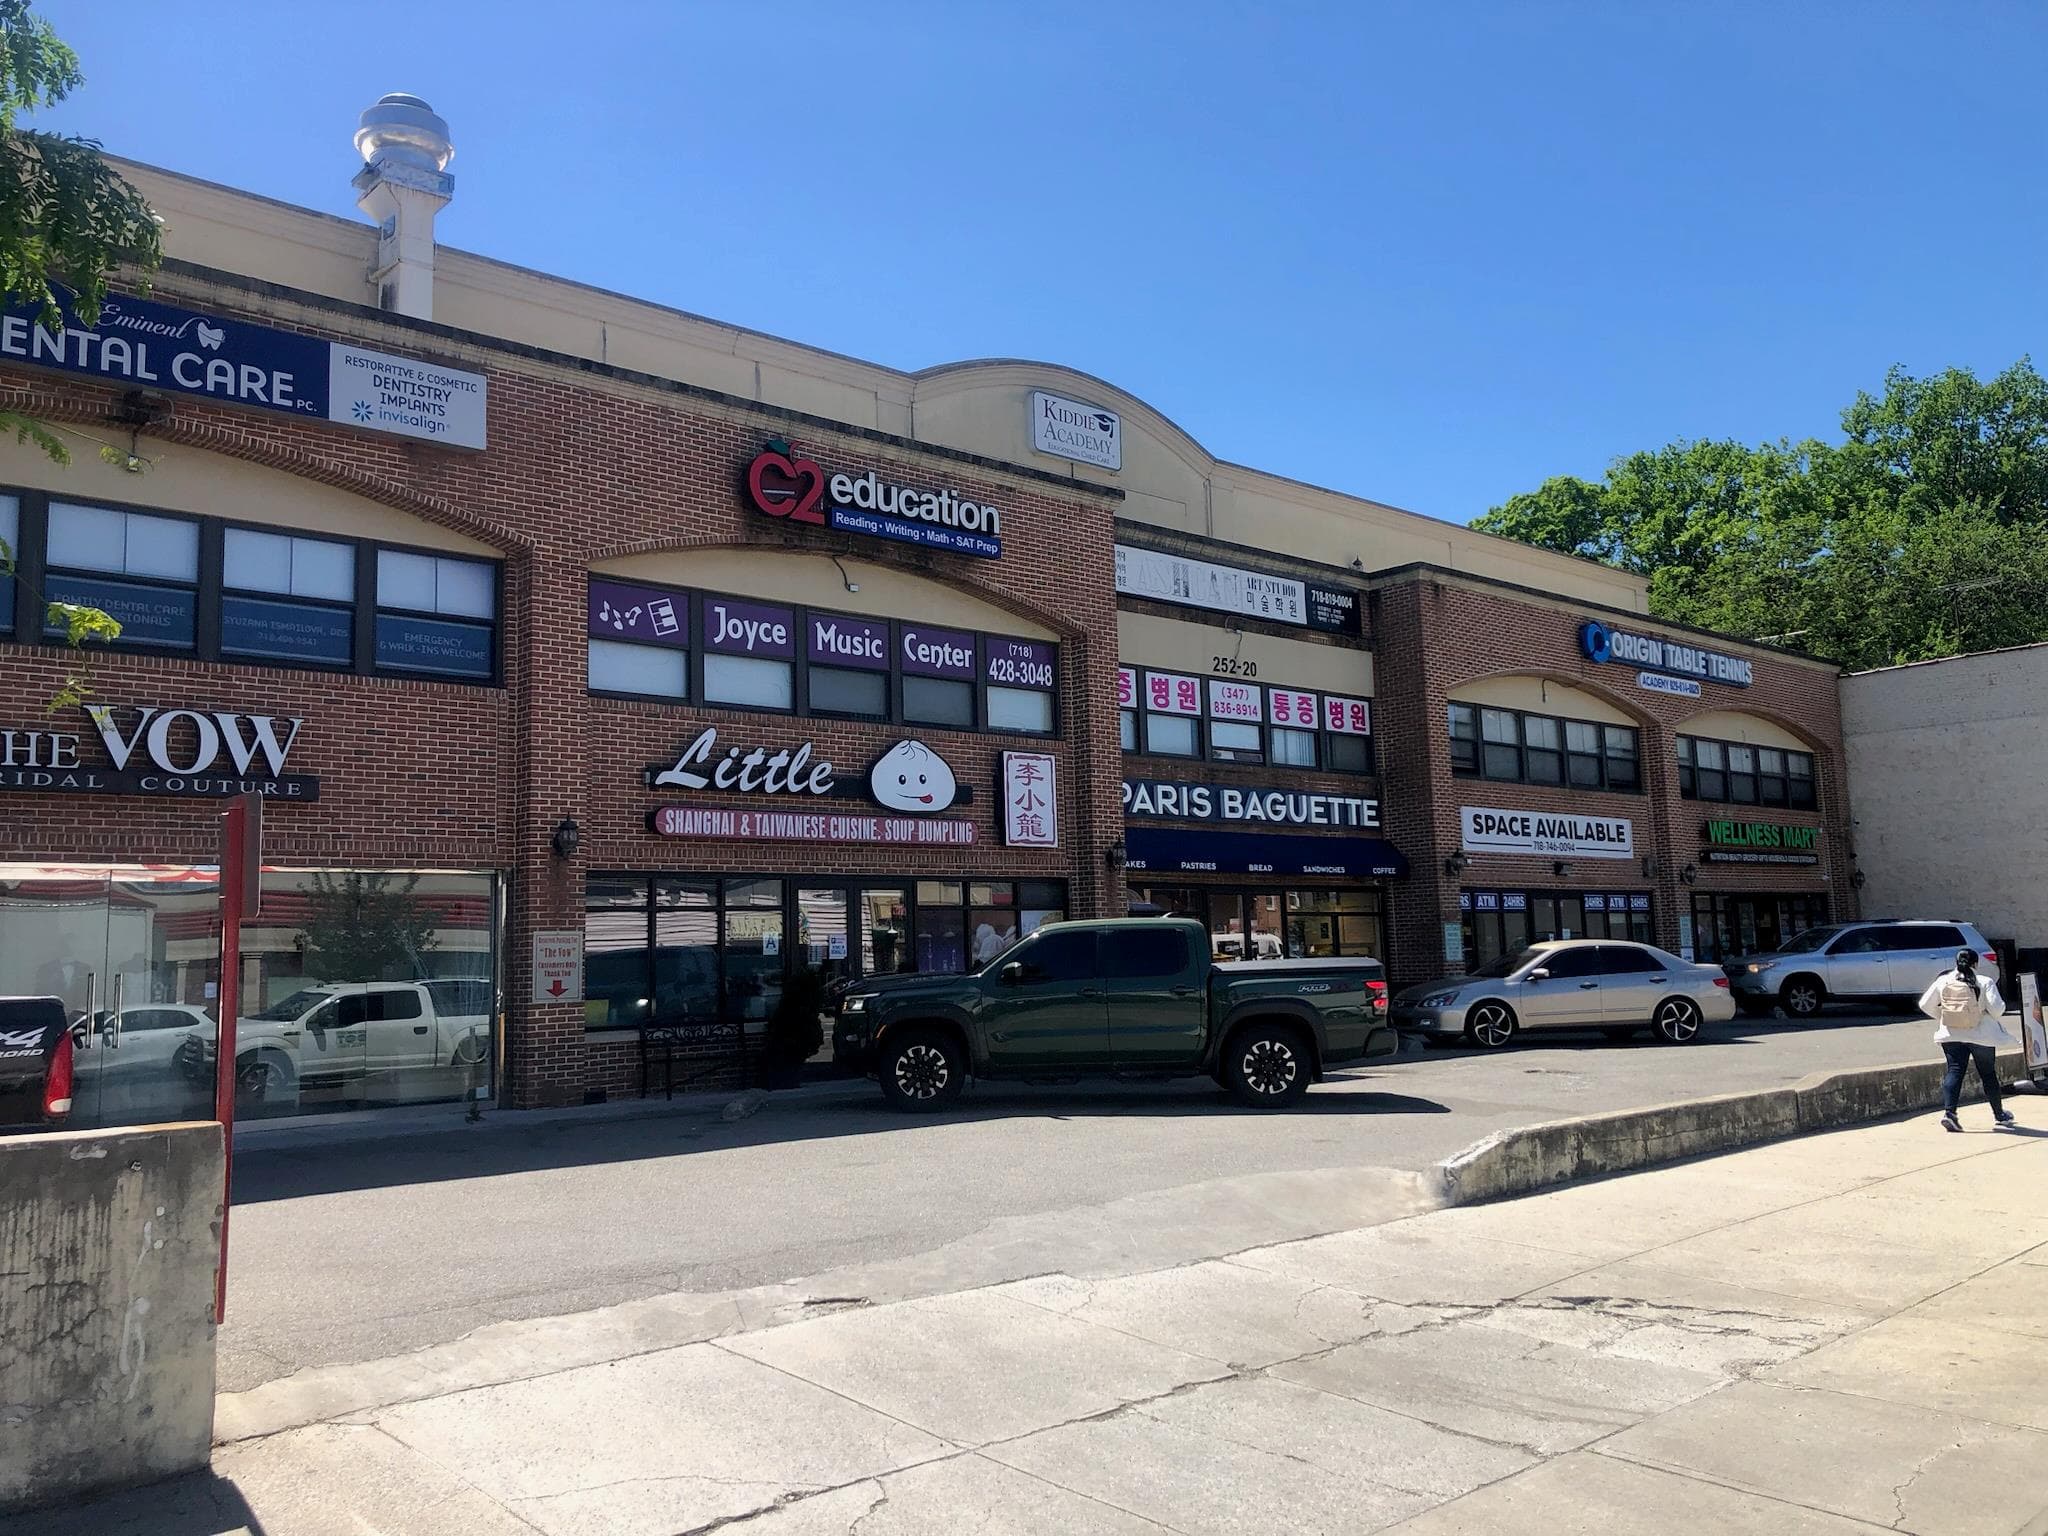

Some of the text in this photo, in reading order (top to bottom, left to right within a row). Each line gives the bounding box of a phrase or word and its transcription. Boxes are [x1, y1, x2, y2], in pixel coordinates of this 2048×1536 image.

[97, 302, 192, 340] Eminent
[1, 315, 294, 407] ENTAL CARE
[345, 355, 478, 393] RESTORATIVE & COSMETIC
[373, 374, 452, 403] DENTISTRY
[380, 392, 446, 416] IMPLANTS
[1043, 398, 1096, 431] KIDDIE
[379, 406, 445, 433] invisalign
[1043, 421, 1112, 454] ACADEMY
[750, 451, 825, 525] C2
[830, 471, 1000, 534] education
[835, 512, 998, 555] Reading Writing Math SAT Prep
[104, 599, 150, 613] DENTAL
[153, 604, 186, 617] CARE
[404, 632, 463, 648] EMERGENCY
[713, 606, 787, 650] Joyce
[815, 621, 883, 659] Music
[440, 645, 488, 661] WELCOME
[904, 633, 973, 669] Center
[1008, 643, 1033, 659] (718)
[1611, 631, 1753, 685] ORIGIN TABLE TENNIS
[988, 658, 1053, 687] 428-3048
[1212, 656, 1257, 677] 252-20
[1150, 676, 1198, 712] 병원
[1221, 687, 1249, 701] (347)
[1214, 701, 1258, 717] 836-8914
[1273, 692, 1368, 732] 통증 병원
[0, 703, 304, 778] HE VOW
[655, 727, 835, 795] Little
[0, 771, 302, 796] IDAL COUTURE
[1014, 762, 1047, 838] 李小籠
[1220, 789, 1380, 828] BAGUETTE
[665, 809, 735, 835] SHANGHAI
[740, 814, 750, 836] &
[754, 813, 826, 839] TAIWANESE
[885, 819, 915, 842] SOUP
[918, 820, 972, 843] DUMPLING
[1472, 813, 1626, 844] SPACE AVAILABLE
[1708, 819, 1818, 849] WELLNESS MART
[1124, 860, 1146, 869] AKES
[1181, 860, 1217, 871] PASTRIES
[1248, 863, 1273, 872] BREAD
[1303, 865, 1345, 874] SANDWICHES
[1372, 866, 1396, 875] COFFEE
[1477, 895, 1496, 907] ATM
[1503, 895, 1525, 907] 24HRS
[1609, 897, 1625, 908] ATM
[765, 938, 776, 949] A
[0, 1048, 45, 1059] OAD
